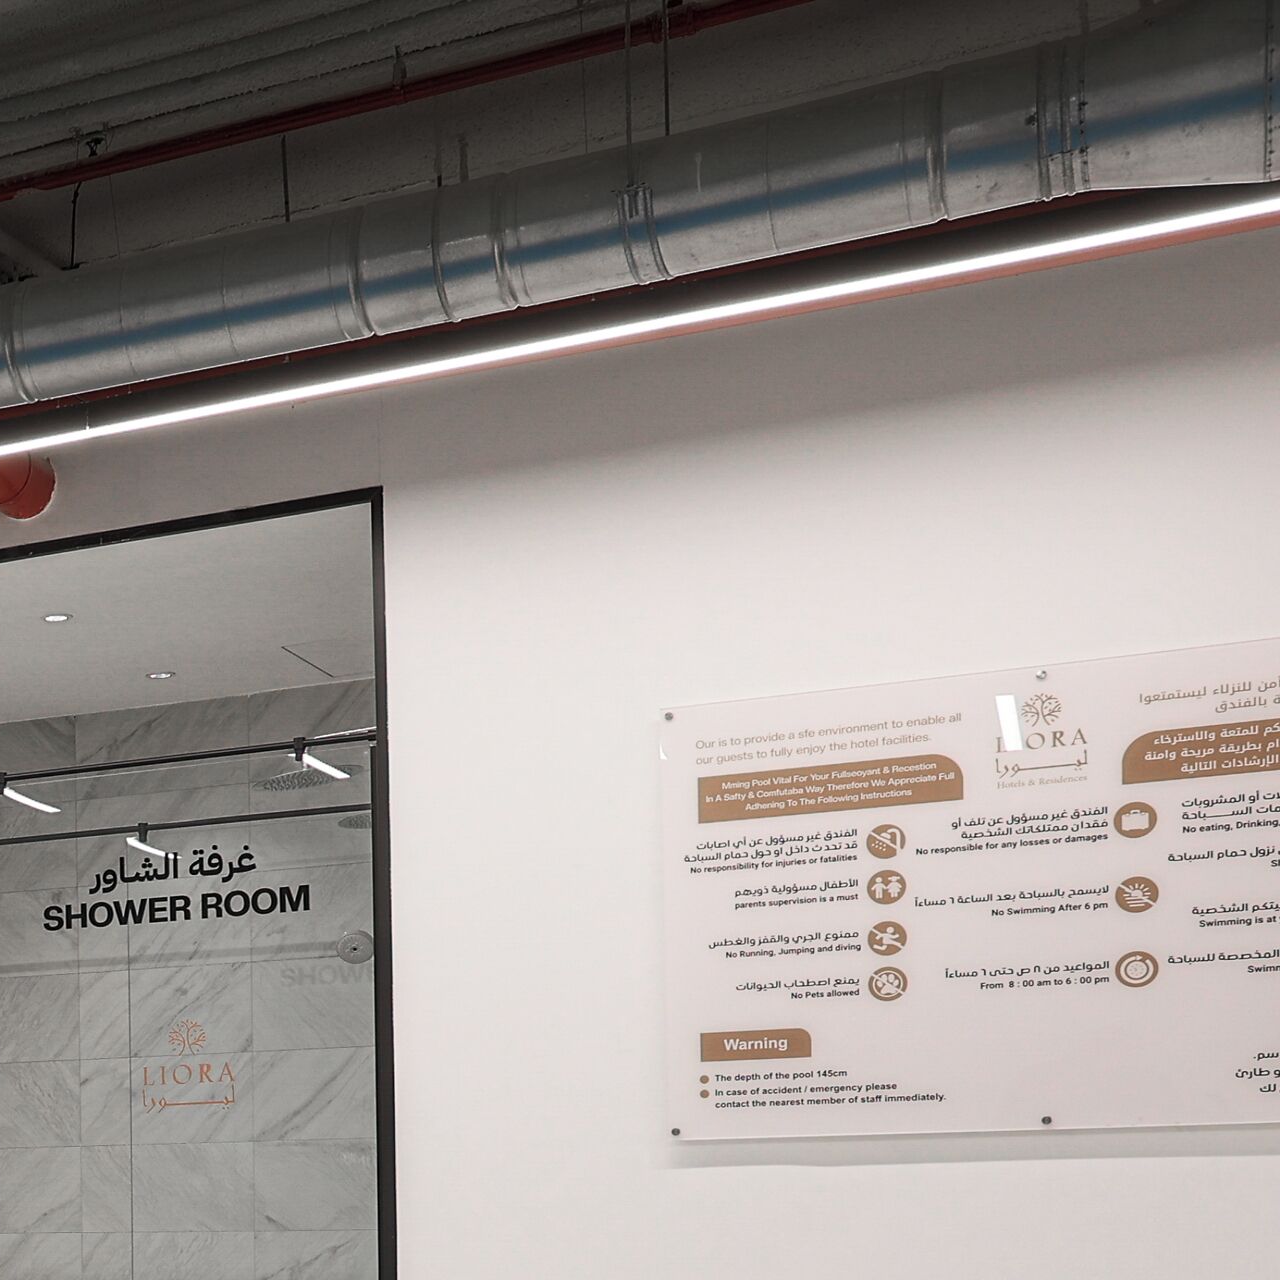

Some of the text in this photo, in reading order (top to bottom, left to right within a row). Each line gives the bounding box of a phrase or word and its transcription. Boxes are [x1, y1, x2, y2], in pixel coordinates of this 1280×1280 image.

[695, 712, 961, 749] Our is to provide a environment to enable all
[696, 738, 879, 765] our guests to fully enjoy the hotel
[1050, 809, 1068, 822] غير
[1070, 806, 1108, 820] الفندق
[1071, 820, 1108, 832] فقدان
[805, 832, 821, 843] غير
[824, 829, 857, 843] الفندق
[931, 843, 983, 855] responsible
[1064, 834, 1108, 843] damages
[88, 844, 256, 895] غرفة الشاور
[704, 862, 759, 873] responsibility
[775, 859, 807, 868] injuries
[820, 854, 857, 863] fatalities
[735, 901, 766, 910] parents
[768, 897, 817, 907] supervision
[836, 893, 858, 901] must
[957, 889, 1065, 904] بالسباحة بعد الساعة
[43, 884, 311, 931] SHOWER ROOM
[1007, 905, 1056, 915] Swimming
[1058, 903, 1082, 911] After
[1084, 902, 1091, 910] 6
[1093, 903, 1108, 911] pm
[1199, 918, 1252, 927] Swimming
[1255, 916, 1264, 924] is
[824, 931, 859, 942] ممنوع
[778, 947, 815, 955] Jumping
[817, 944, 833, 952] and
[1043, 966, 1060, 975] من
[1063, 961, 1109, 973] المواعيد
[980, 982, 1004, 990] From
[1094, 977, 1109, 985] pm
[827, 988, 860, 997] allowed
[724, 1037, 787, 1051] Warning
[143, 1062, 236, 1086] LIORA
[715, 1074, 732, 1082] The
[734, 1073, 761, 1082] depth
[763, 1072, 773, 1080] of
[793, 1071, 813, 1080] pool
[750, 1087, 760, 1095] of
[762, 1086, 802, 1094] accident
[810, 1085, 863, 1094] emergency
[865, 1083, 897, 1092] please
[715, 1100, 749, 1108] contact
[807, 1097, 846, 1105] member
[861, 1095, 882, 1103] staff
